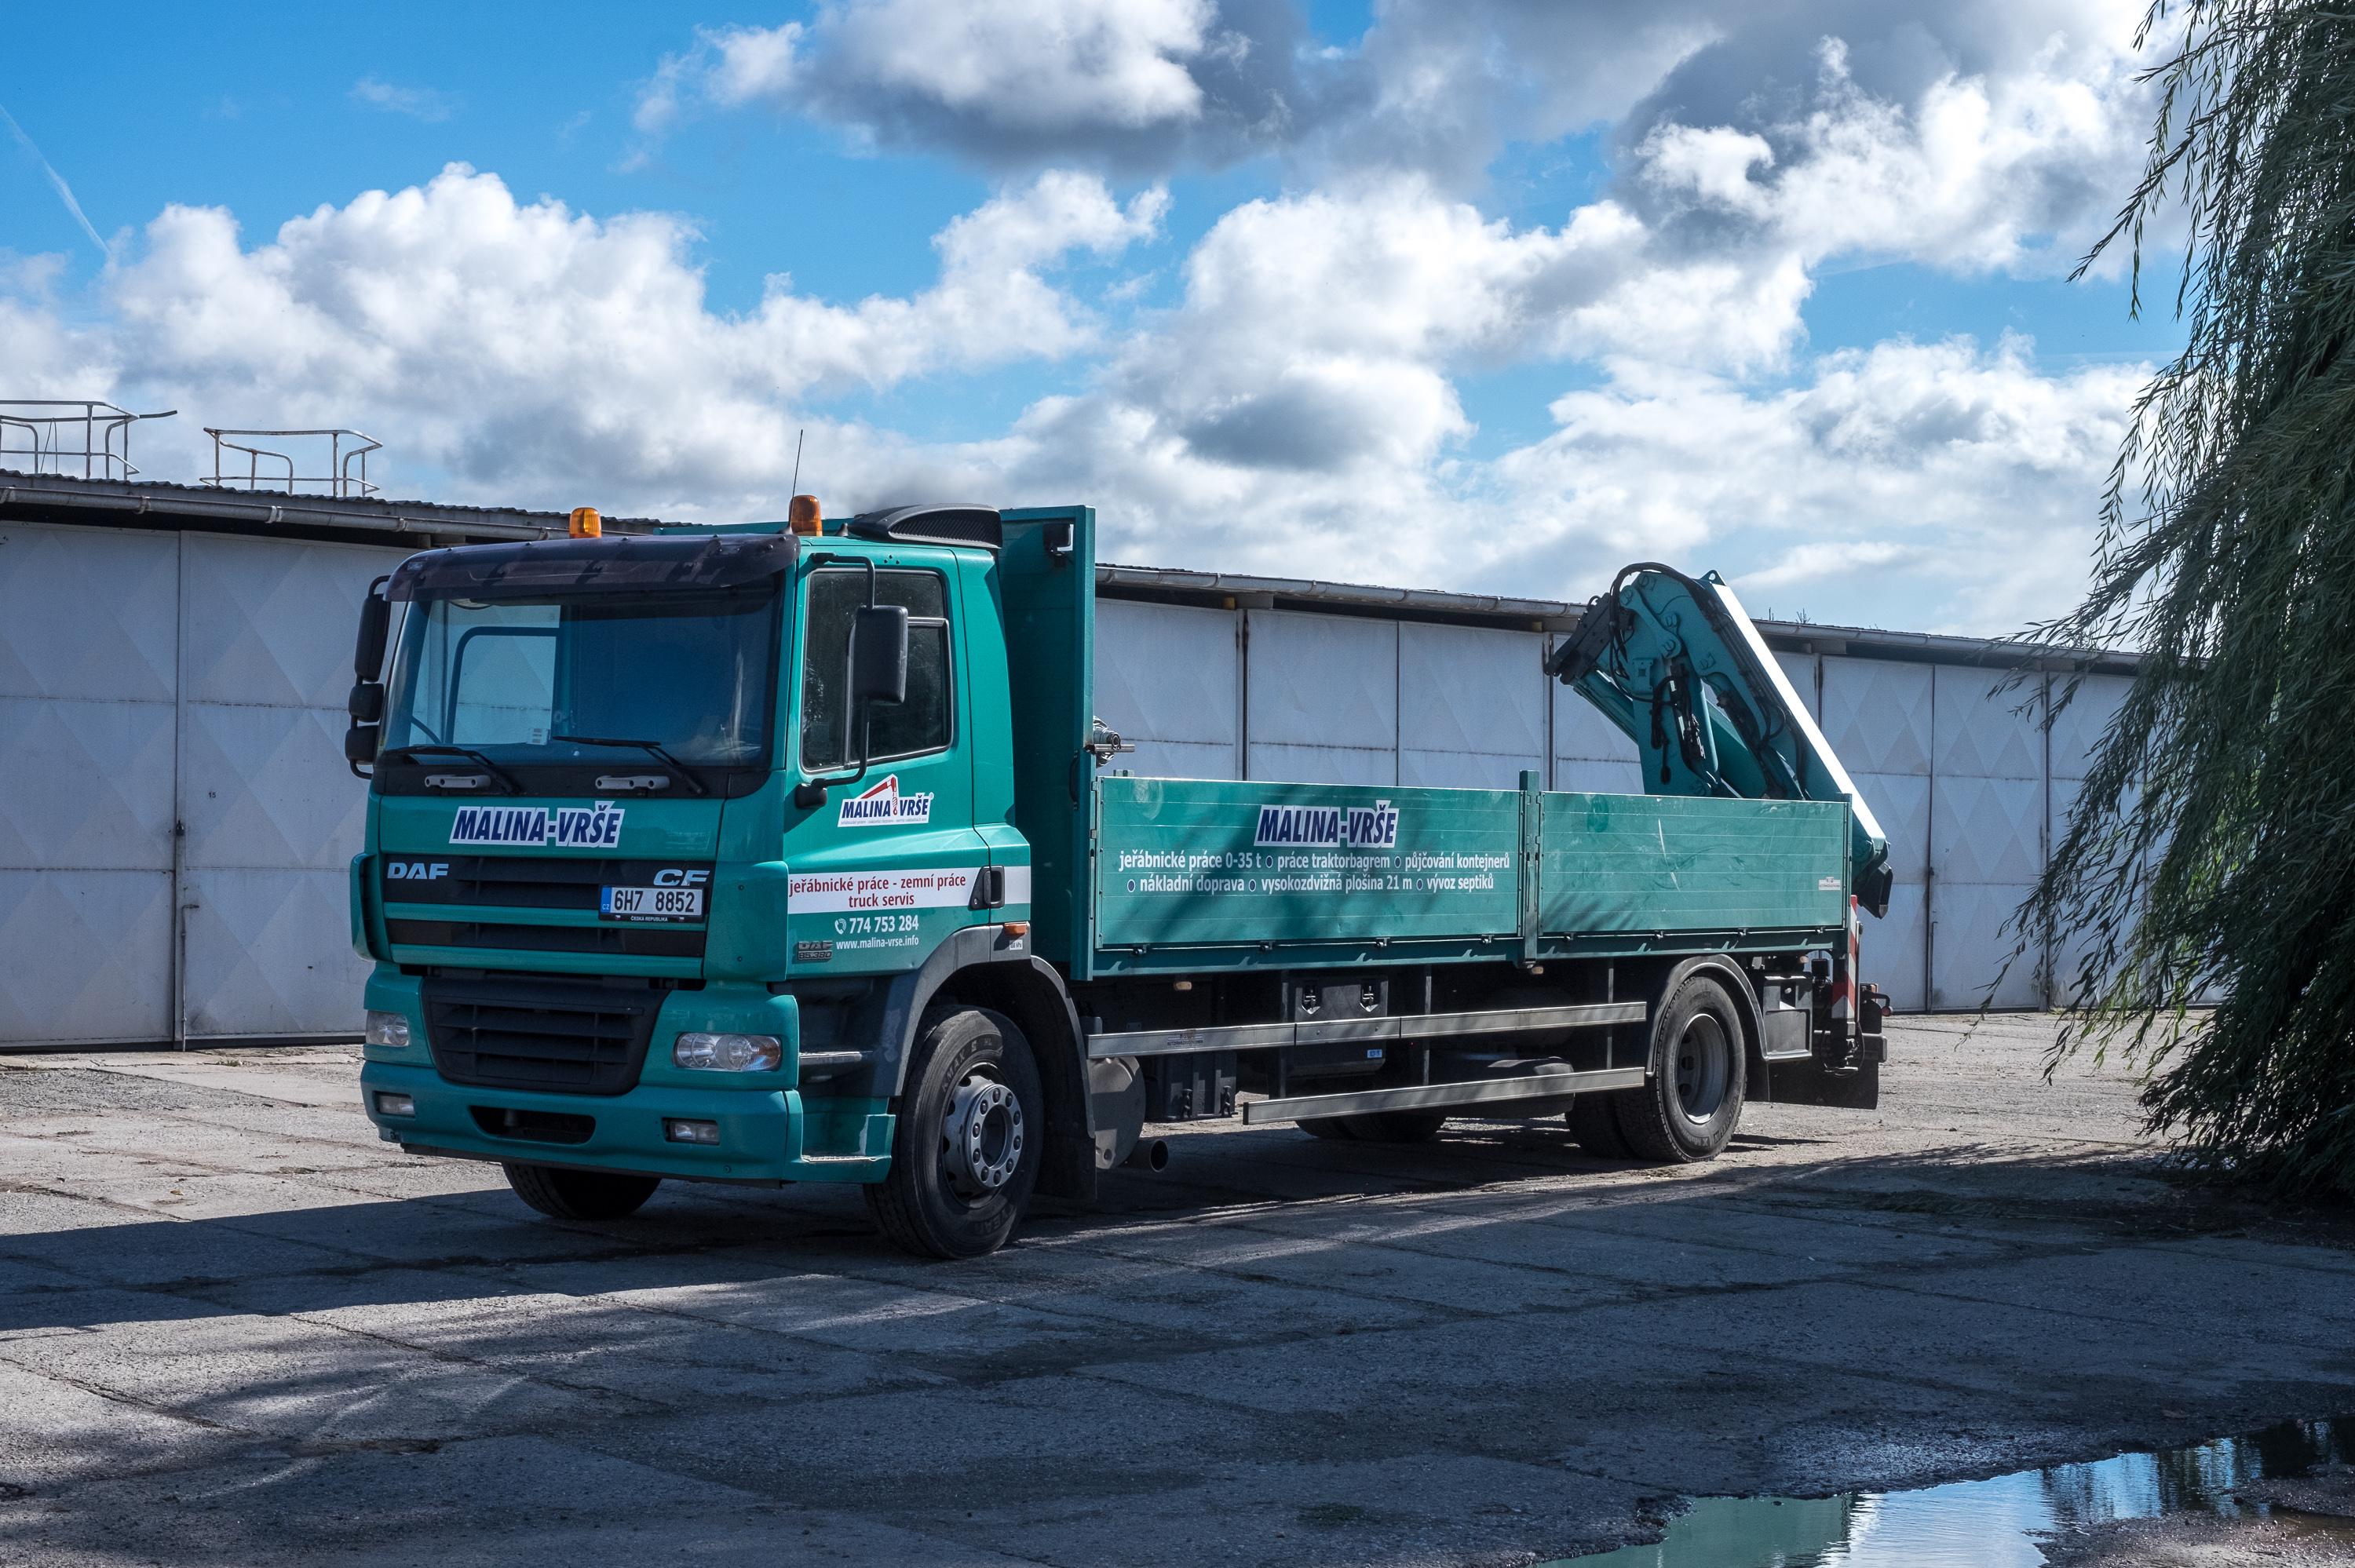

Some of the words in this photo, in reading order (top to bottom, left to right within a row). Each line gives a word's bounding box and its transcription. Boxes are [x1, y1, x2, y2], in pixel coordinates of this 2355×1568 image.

[842, 801, 891, 819] MALINA
[899, 797, 929, 816] VRŠE
[453, 804, 621, 844] MALINA-VRŠE
[1258, 805, 1397, 844] MALINA-VRŠE
[387, 862, 449, 880] DAF
[1119, 850, 1185, 872] jeřábnické
[1188, 851, 1222, 872] práce
[1225, 852, 1253, 869] 0-35
[1256, 854, 1261, 869] t
[1277, 851, 1309, 872] práce
[1312, 853, 1389, 872] traktorbagrem
[1405, 852, 1454, 872] půjčování
[1457, 852, 1510, 872] kontejnerů
[653, 869, 710, 886] CF
[790, 877, 853, 896] jeřábnické
[857, 876, 889, 897] práce
[900, 873, 933, 889] zemní
[937, 873, 966, 894] práce
[1140, 873, 1193, 892] nákladní
[1196, 875, 1244, 895] doprava
[1261, 873, 1342, 895] vysokozdvižná
[1345, 873, 1383, 894] plošina
[1386, 877, 1400, 890] 21
[1403, 879, 1412, 890] m
[1427, 873, 1455, 893] vývoz
[1458, 873, 1494, 893] septiků
[614, 890, 644, 911] 6H7
[655, 891, 695, 913] 8852
[849, 894, 878, 908] truck
[882, 892, 915, 906] servis
[849, 917, 871, 934] 774
[874, 916, 895, 933] 753
[898, 914, 919, 932] 284
[798, 940, 833, 950] DAF
[836, 935, 919, 950] www.malina-vrse.info
